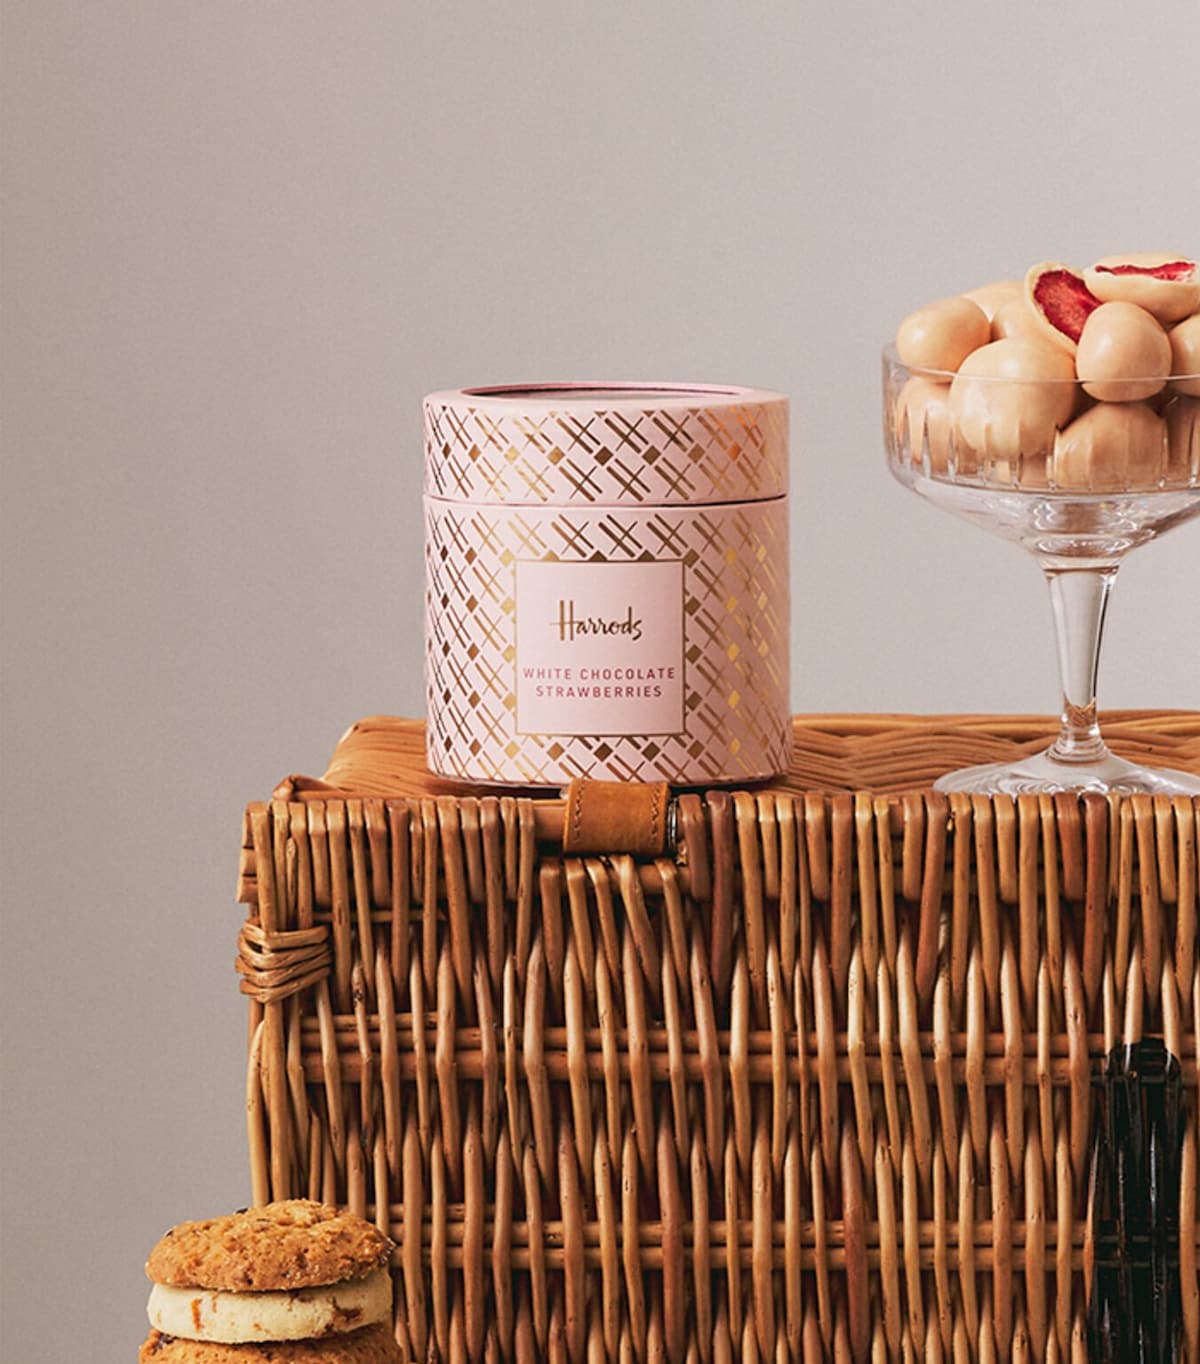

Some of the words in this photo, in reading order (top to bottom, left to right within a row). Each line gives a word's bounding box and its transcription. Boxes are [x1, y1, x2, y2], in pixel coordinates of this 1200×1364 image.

[550, 600, 643, 641] Harrods
[523, 667, 573, 680] WHITE
[580, 667, 676, 681] CHOCOLATE
[536, 685, 663, 699] STRAWBERRIES
